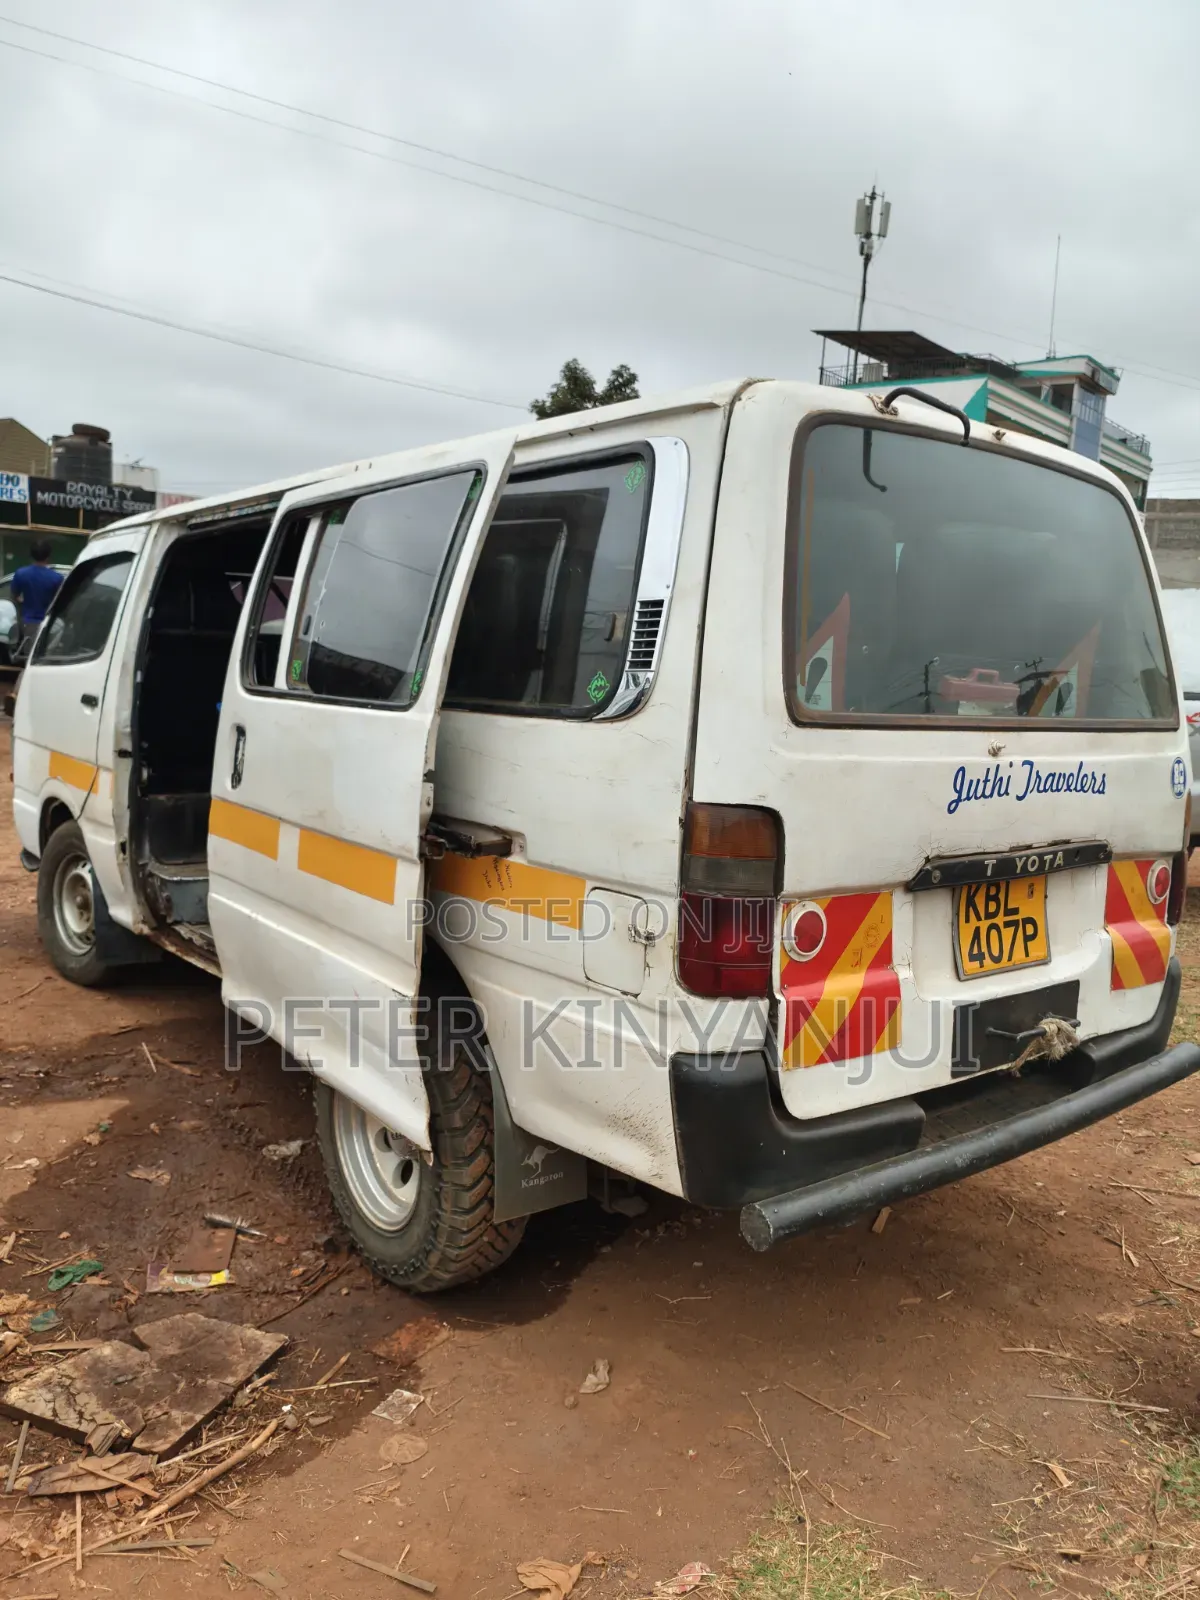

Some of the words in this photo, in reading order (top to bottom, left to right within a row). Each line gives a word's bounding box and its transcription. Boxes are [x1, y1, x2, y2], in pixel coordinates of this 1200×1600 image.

[36, 490, 119, 512] MOTORCYCLE
[66, 481, 133, 500] ROYALTY
[1015, 760, 1107, 801] Travelers
[963, 879, 1020, 924] KBL
[967, 917, 1039, 968] 407P
